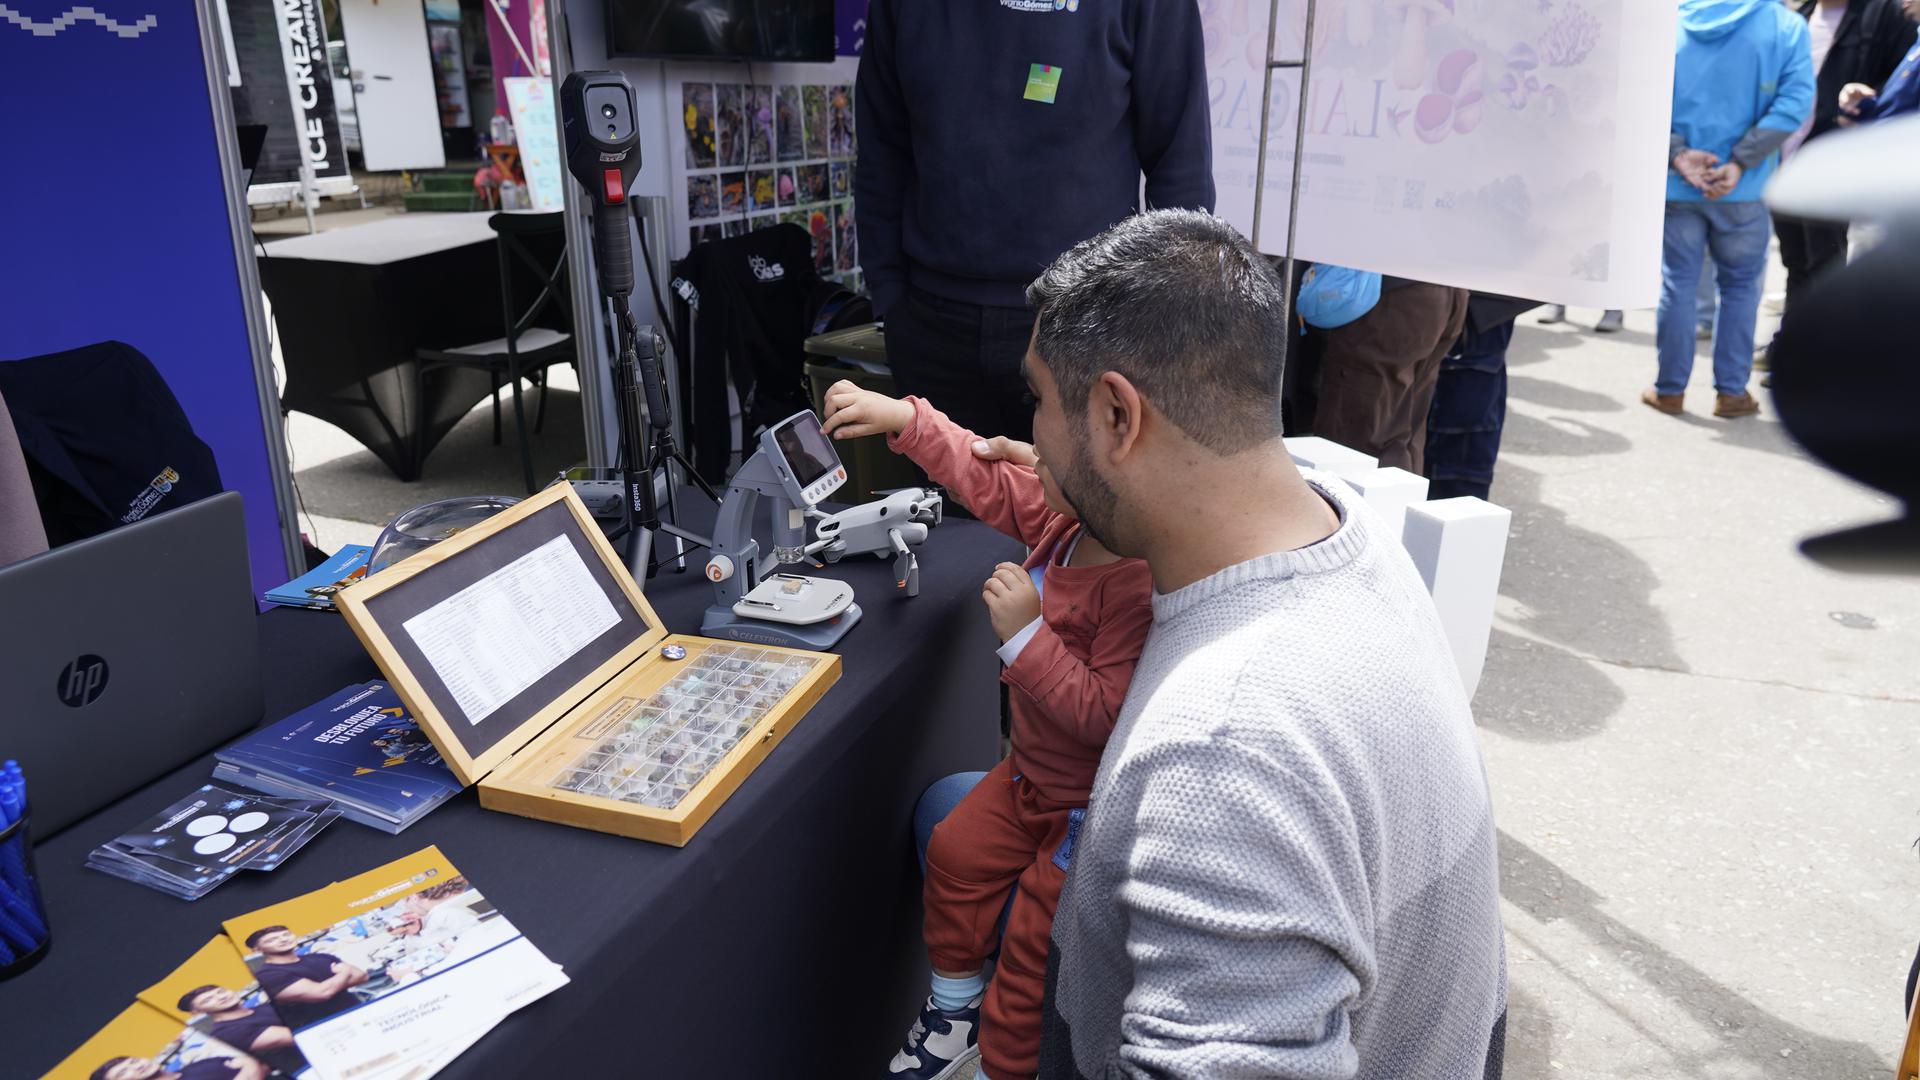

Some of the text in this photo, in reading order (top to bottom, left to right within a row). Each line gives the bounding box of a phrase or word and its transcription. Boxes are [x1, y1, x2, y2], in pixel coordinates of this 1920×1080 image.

[284, 0, 329, 171] ICE CREAM
[632, 483, 641, 511] Insta360
[740, 632, 788, 645] CELESTRON
[65, 655, 103, 706] hp
[313, 705, 382, 743] DESBLOQUEA
[329, 713, 387, 745] TU FUTURO
[381, 1005, 443, 1034] INDUSTRIAL
